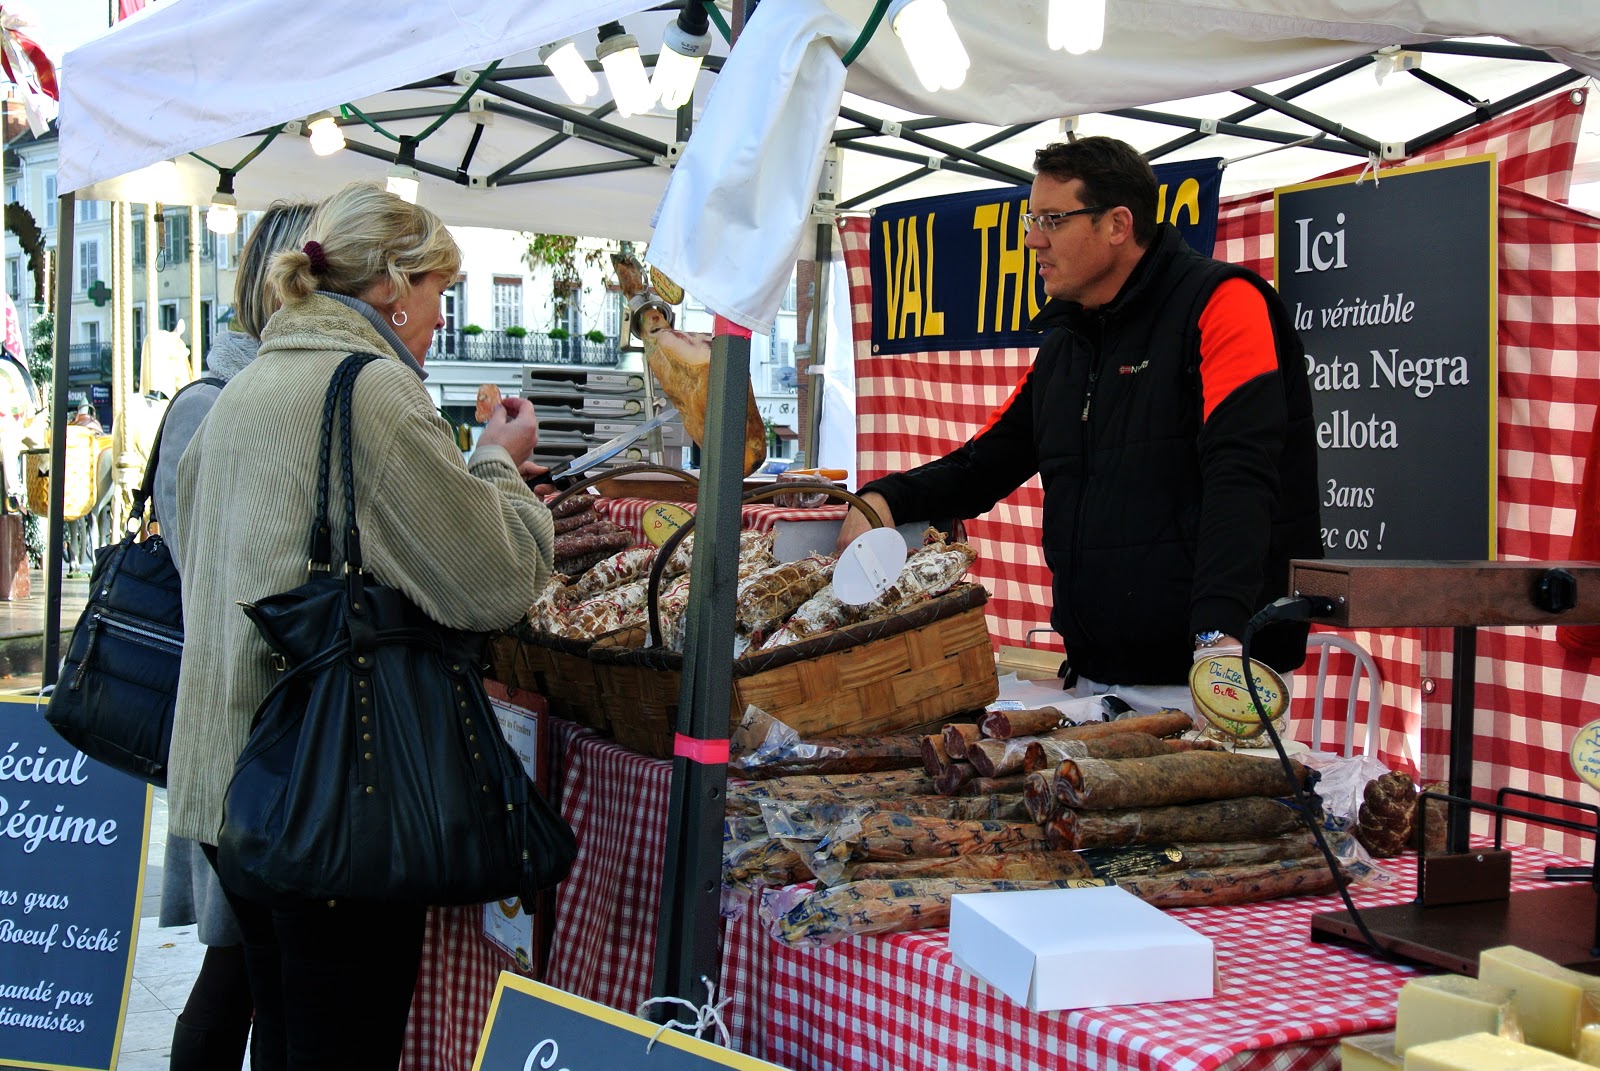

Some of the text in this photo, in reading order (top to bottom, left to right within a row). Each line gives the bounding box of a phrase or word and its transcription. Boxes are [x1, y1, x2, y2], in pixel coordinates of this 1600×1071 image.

[1295, 212, 1348, 273] Ici
[882, 212, 945, 340] VAL
[1294, 292, 1415, 331] la véritable
[770, 320, 779, 356] OTEL
[1370, 348, 1470, 398] Negra
[1316, 409, 1399, 449] ellota
[1323, 478, 1375, 508] 3ans
[1345, 528, 1369, 550] os
[1376, 521, 1386, 551] !
[23, 892, 69, 914] gras
[0, 918, 121, 953] Boeuf Séché
[0, 980, 94, 1010] andé par
